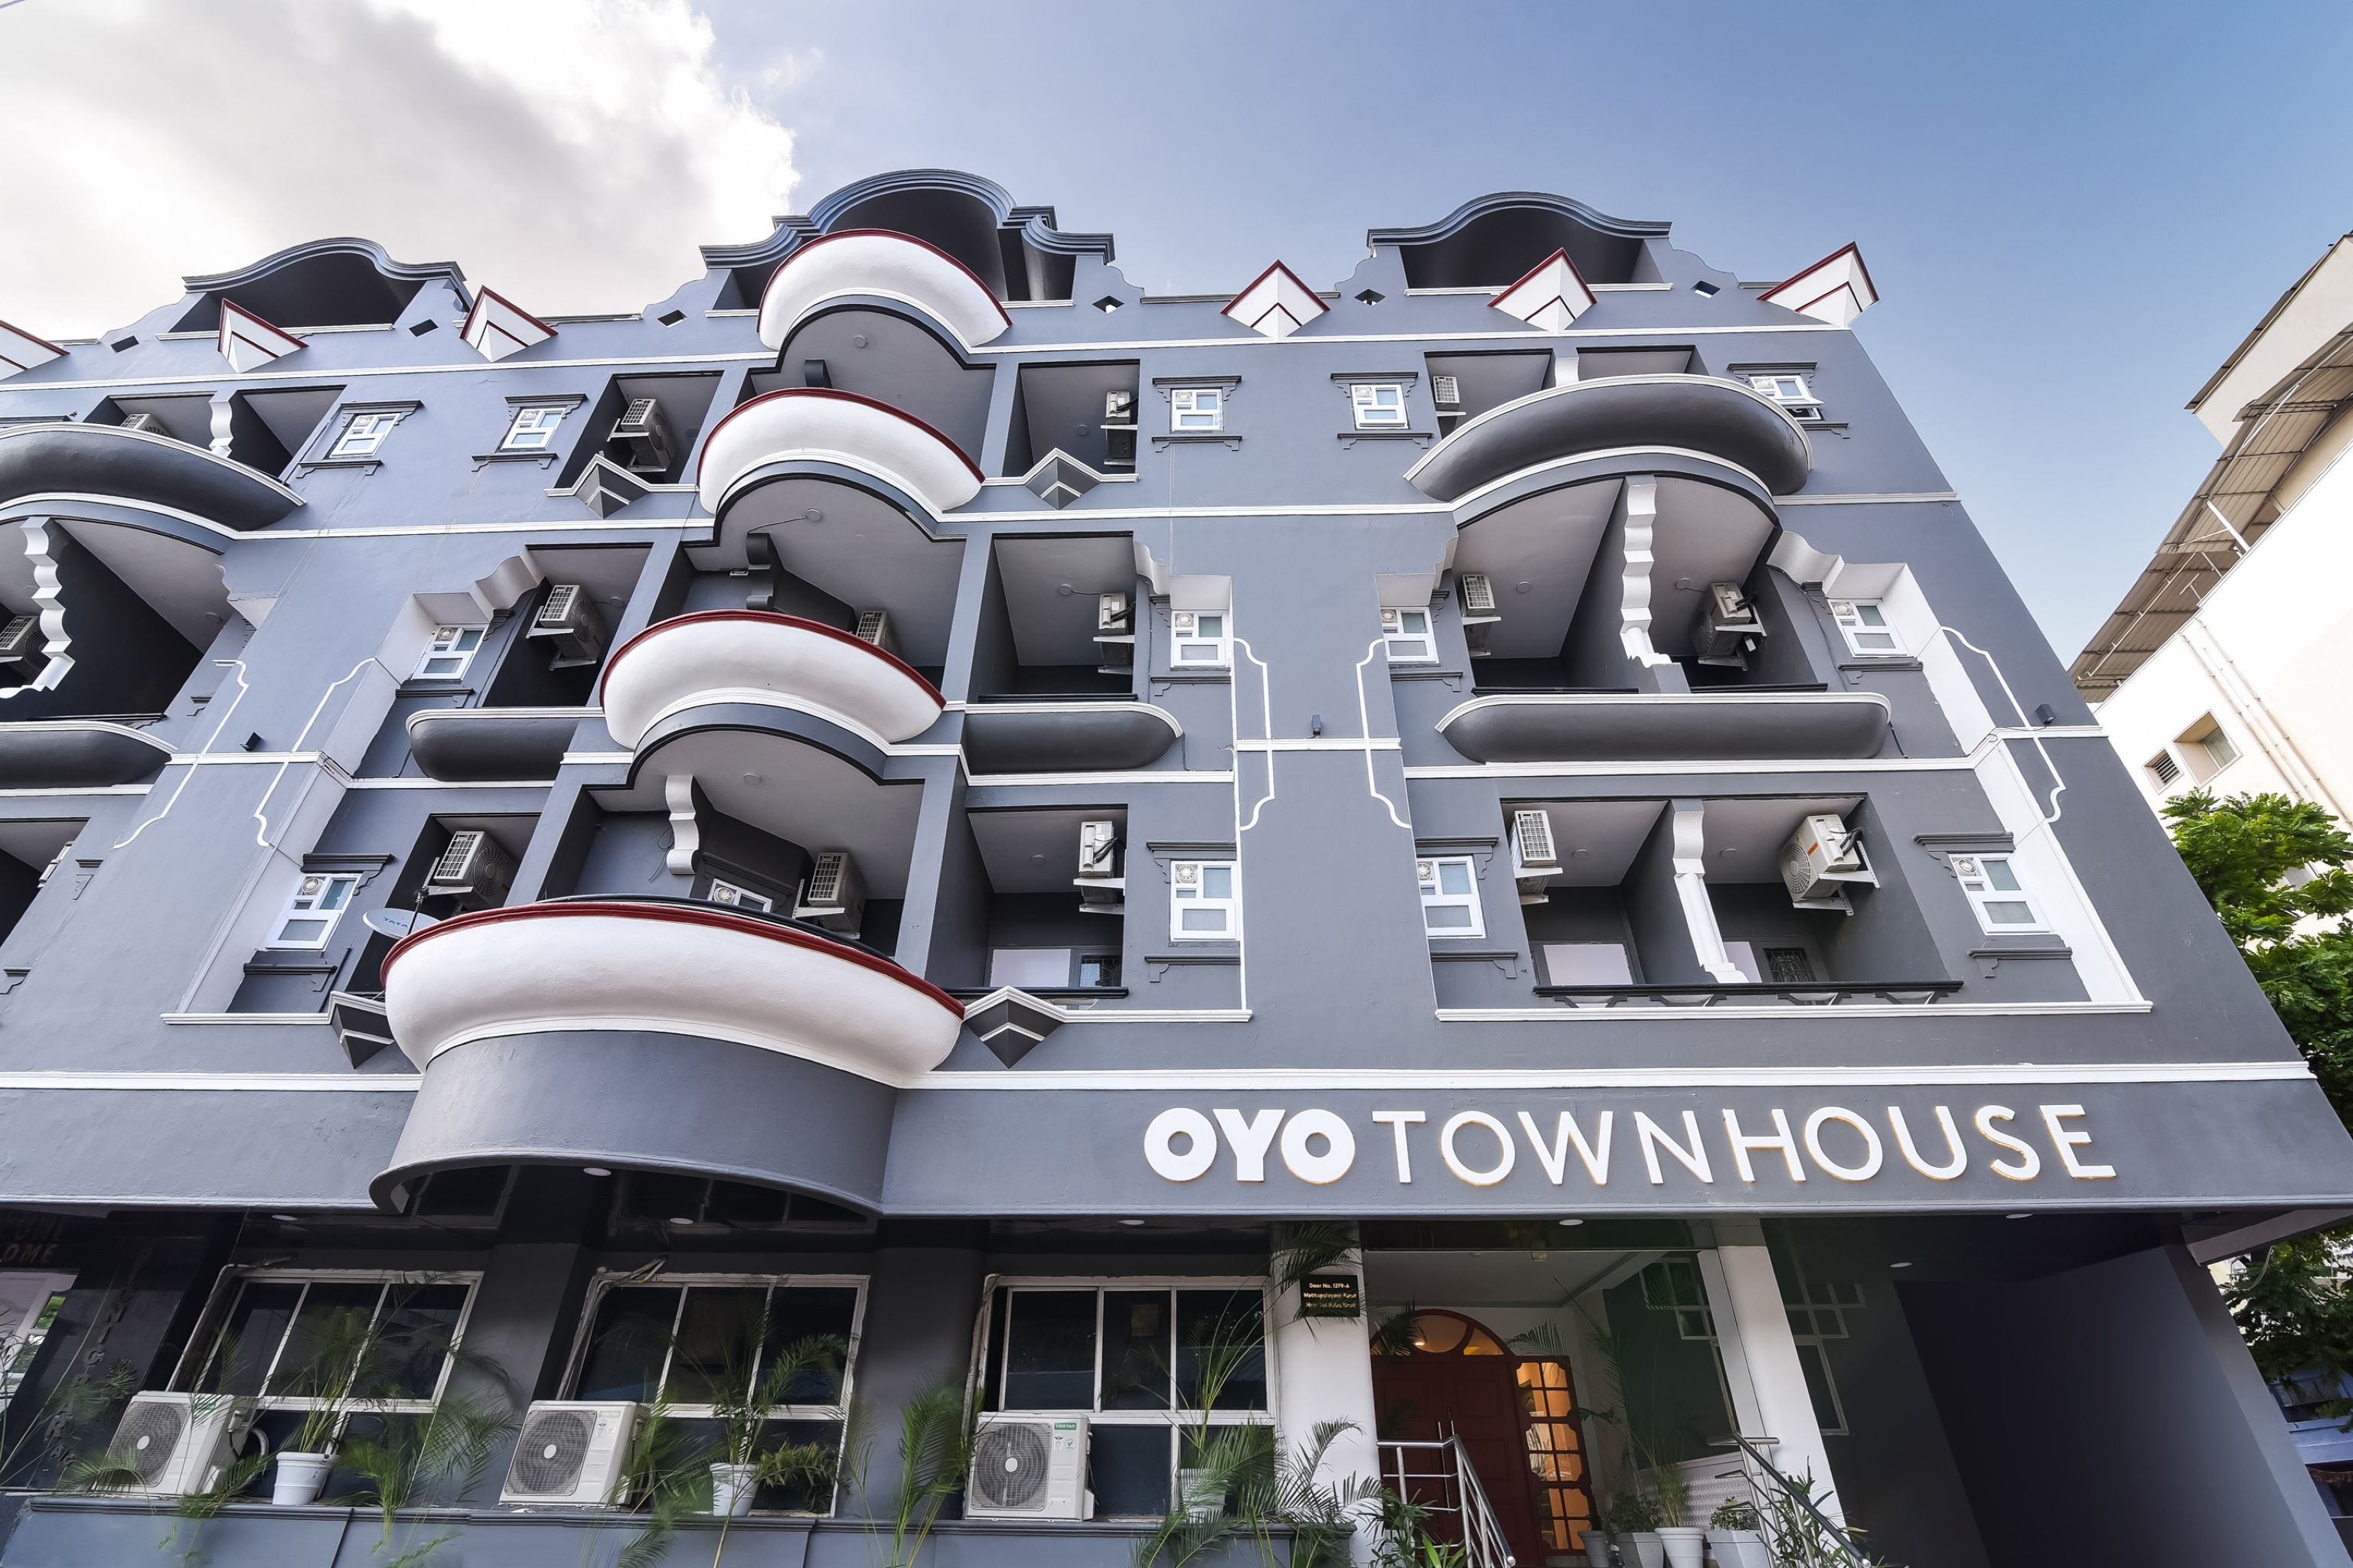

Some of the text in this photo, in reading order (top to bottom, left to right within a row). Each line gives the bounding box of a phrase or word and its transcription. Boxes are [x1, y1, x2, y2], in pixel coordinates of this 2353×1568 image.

[383, 918, 408, 927] TATA
[1144, 1104, 2116, 1185] OYO TOWNHOUSE
